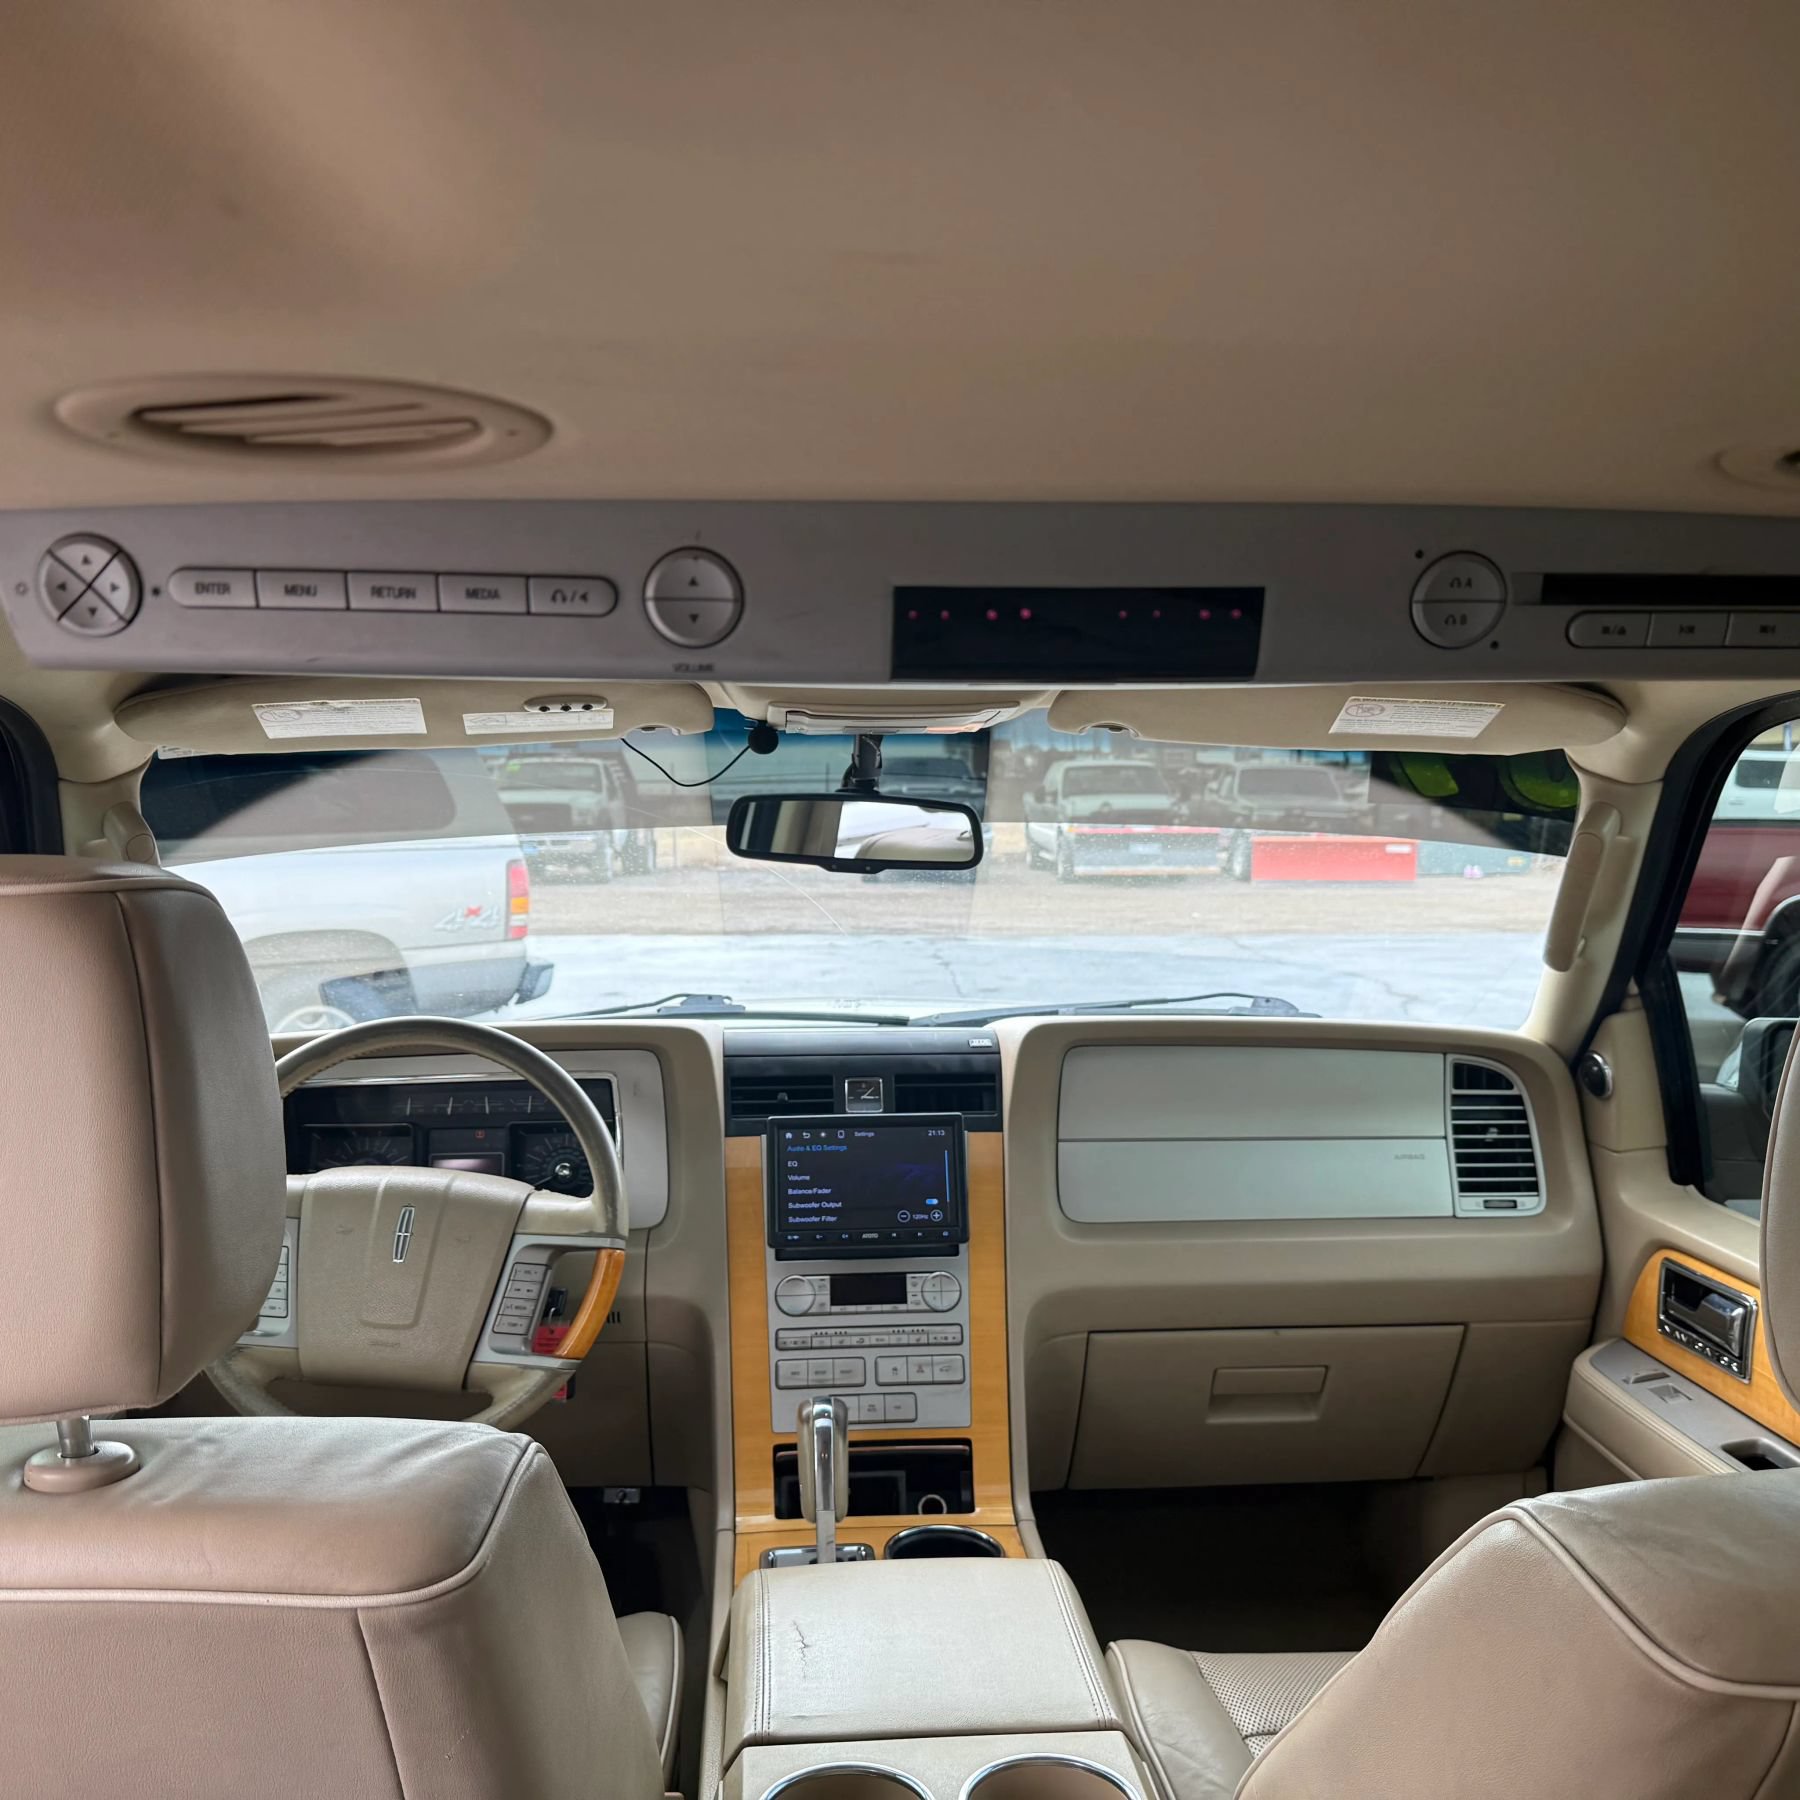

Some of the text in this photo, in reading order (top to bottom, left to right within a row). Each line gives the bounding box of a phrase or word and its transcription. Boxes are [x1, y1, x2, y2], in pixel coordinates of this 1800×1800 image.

[194, 581, 231, 596] ENTER
[284, 583, 317, 598] MENU
[370, 585, 417, 600] RETURN
[465, 587, 501, 601] MEDIA
[672, 662, 715, 673] VOLUME
[787, 1160, 798, 1168] EQ
[788, 1201, 842, 1209] Subwoofer Output
[788, 1215, 820, 1223] Subwoofer
